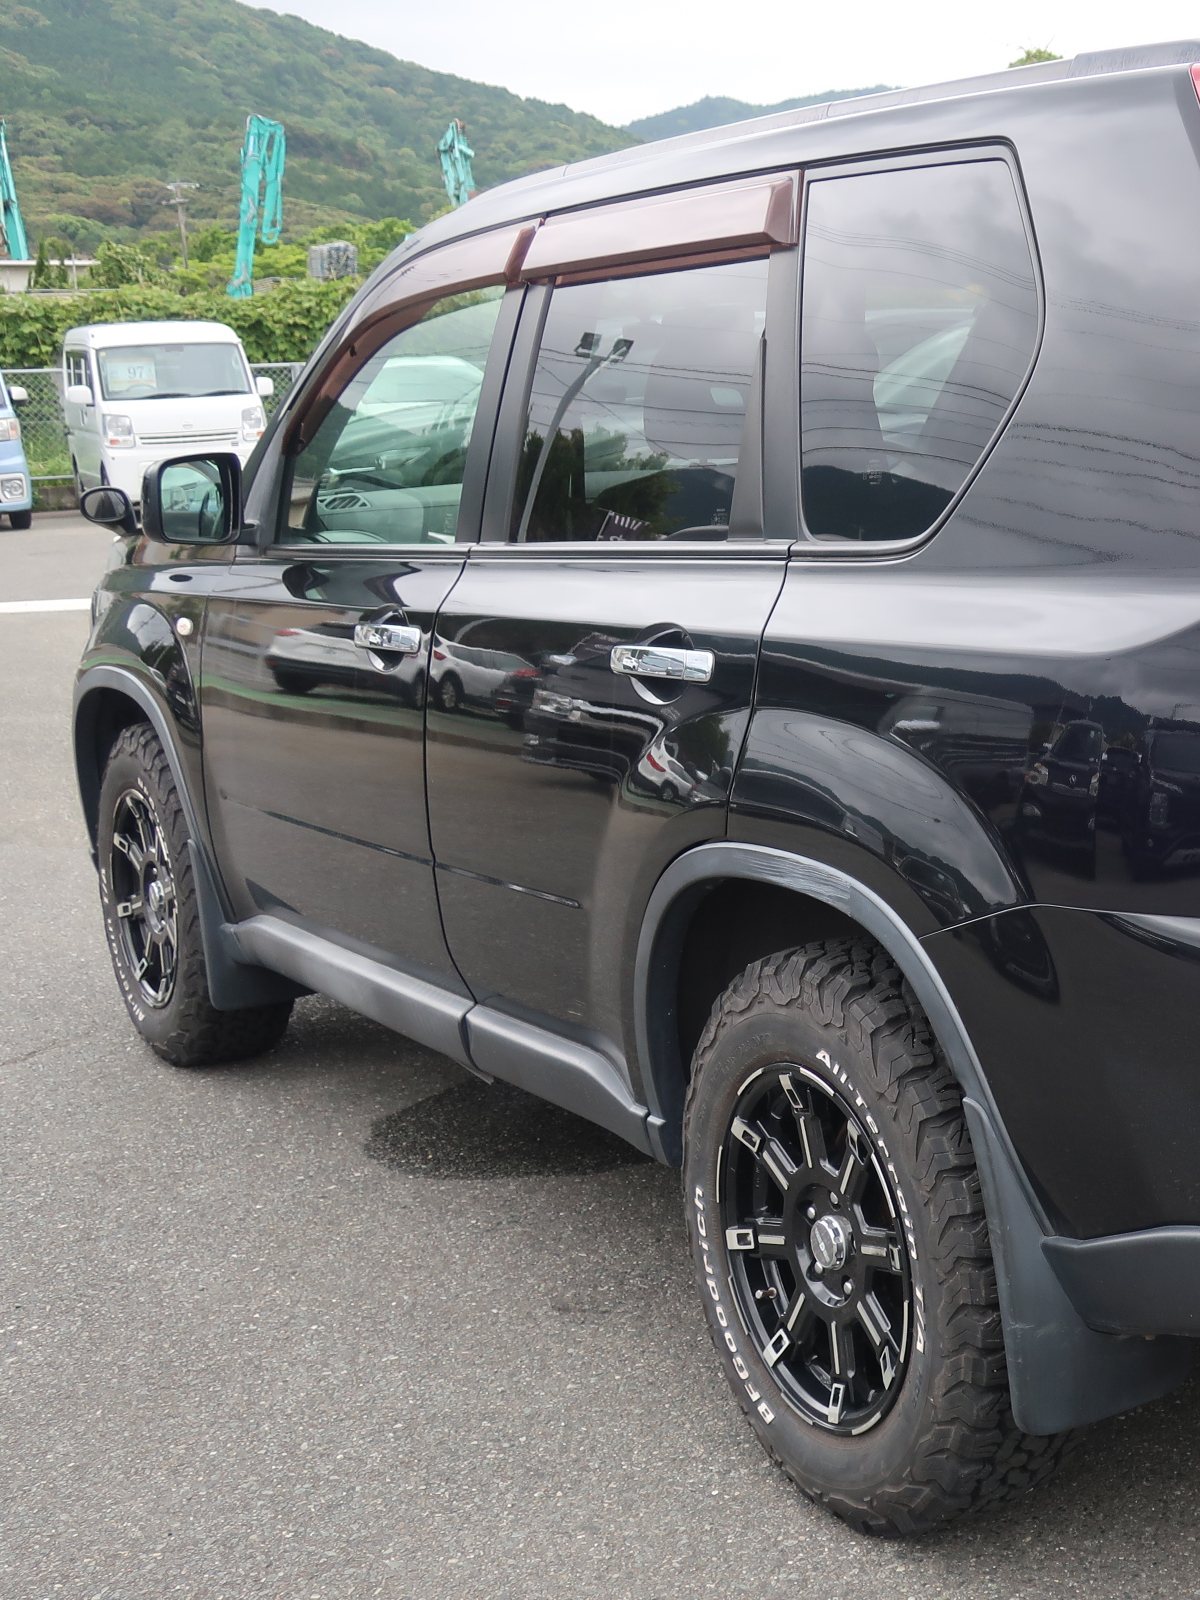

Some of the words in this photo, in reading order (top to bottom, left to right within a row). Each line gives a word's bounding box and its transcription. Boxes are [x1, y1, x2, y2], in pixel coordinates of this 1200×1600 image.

[694, 1185, 775, 1425] BFGoodrich
[815, 1049, 918, 1261] All-Terrain
[915, 1287, 926, 1354] T/A
